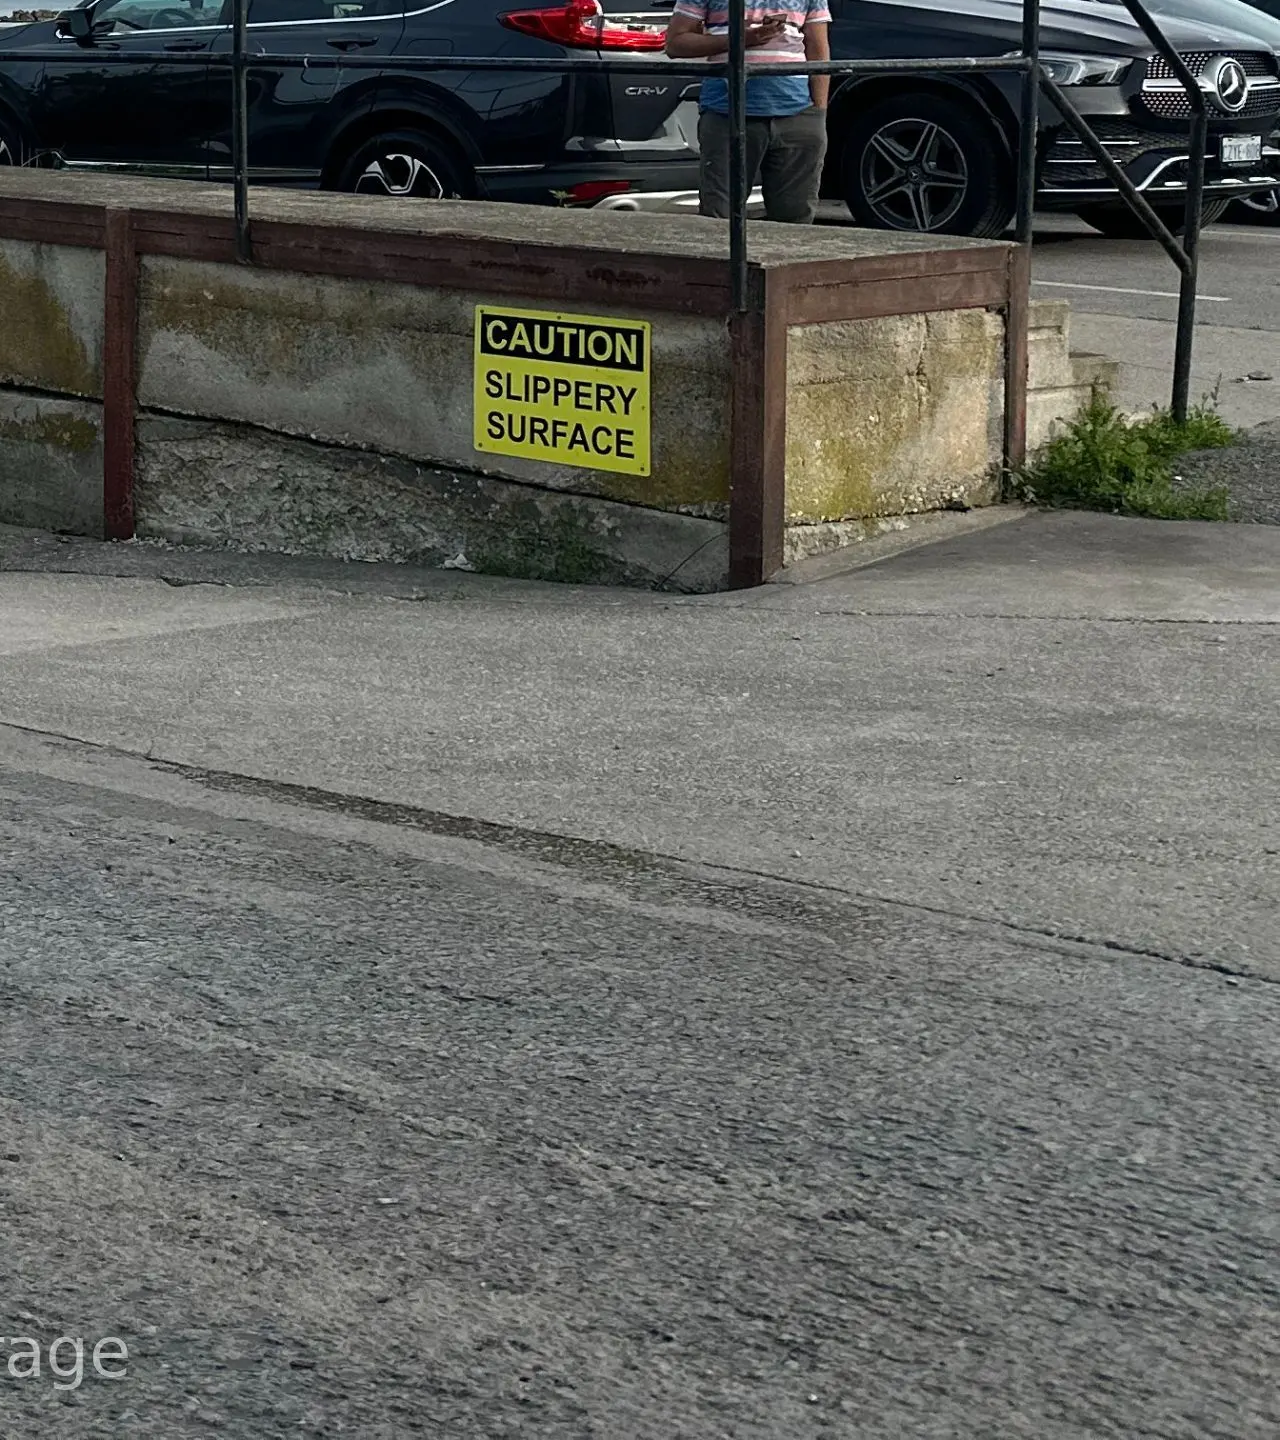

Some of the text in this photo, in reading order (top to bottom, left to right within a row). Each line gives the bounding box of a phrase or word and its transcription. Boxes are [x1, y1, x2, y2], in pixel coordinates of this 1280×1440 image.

[624, 86, 669, 96] CR-V
[486, 319, 637, 365] CAUTION
[485, 370, 637, 415] SLIPPERY
[487, 411, 635, 459] SURFACE
